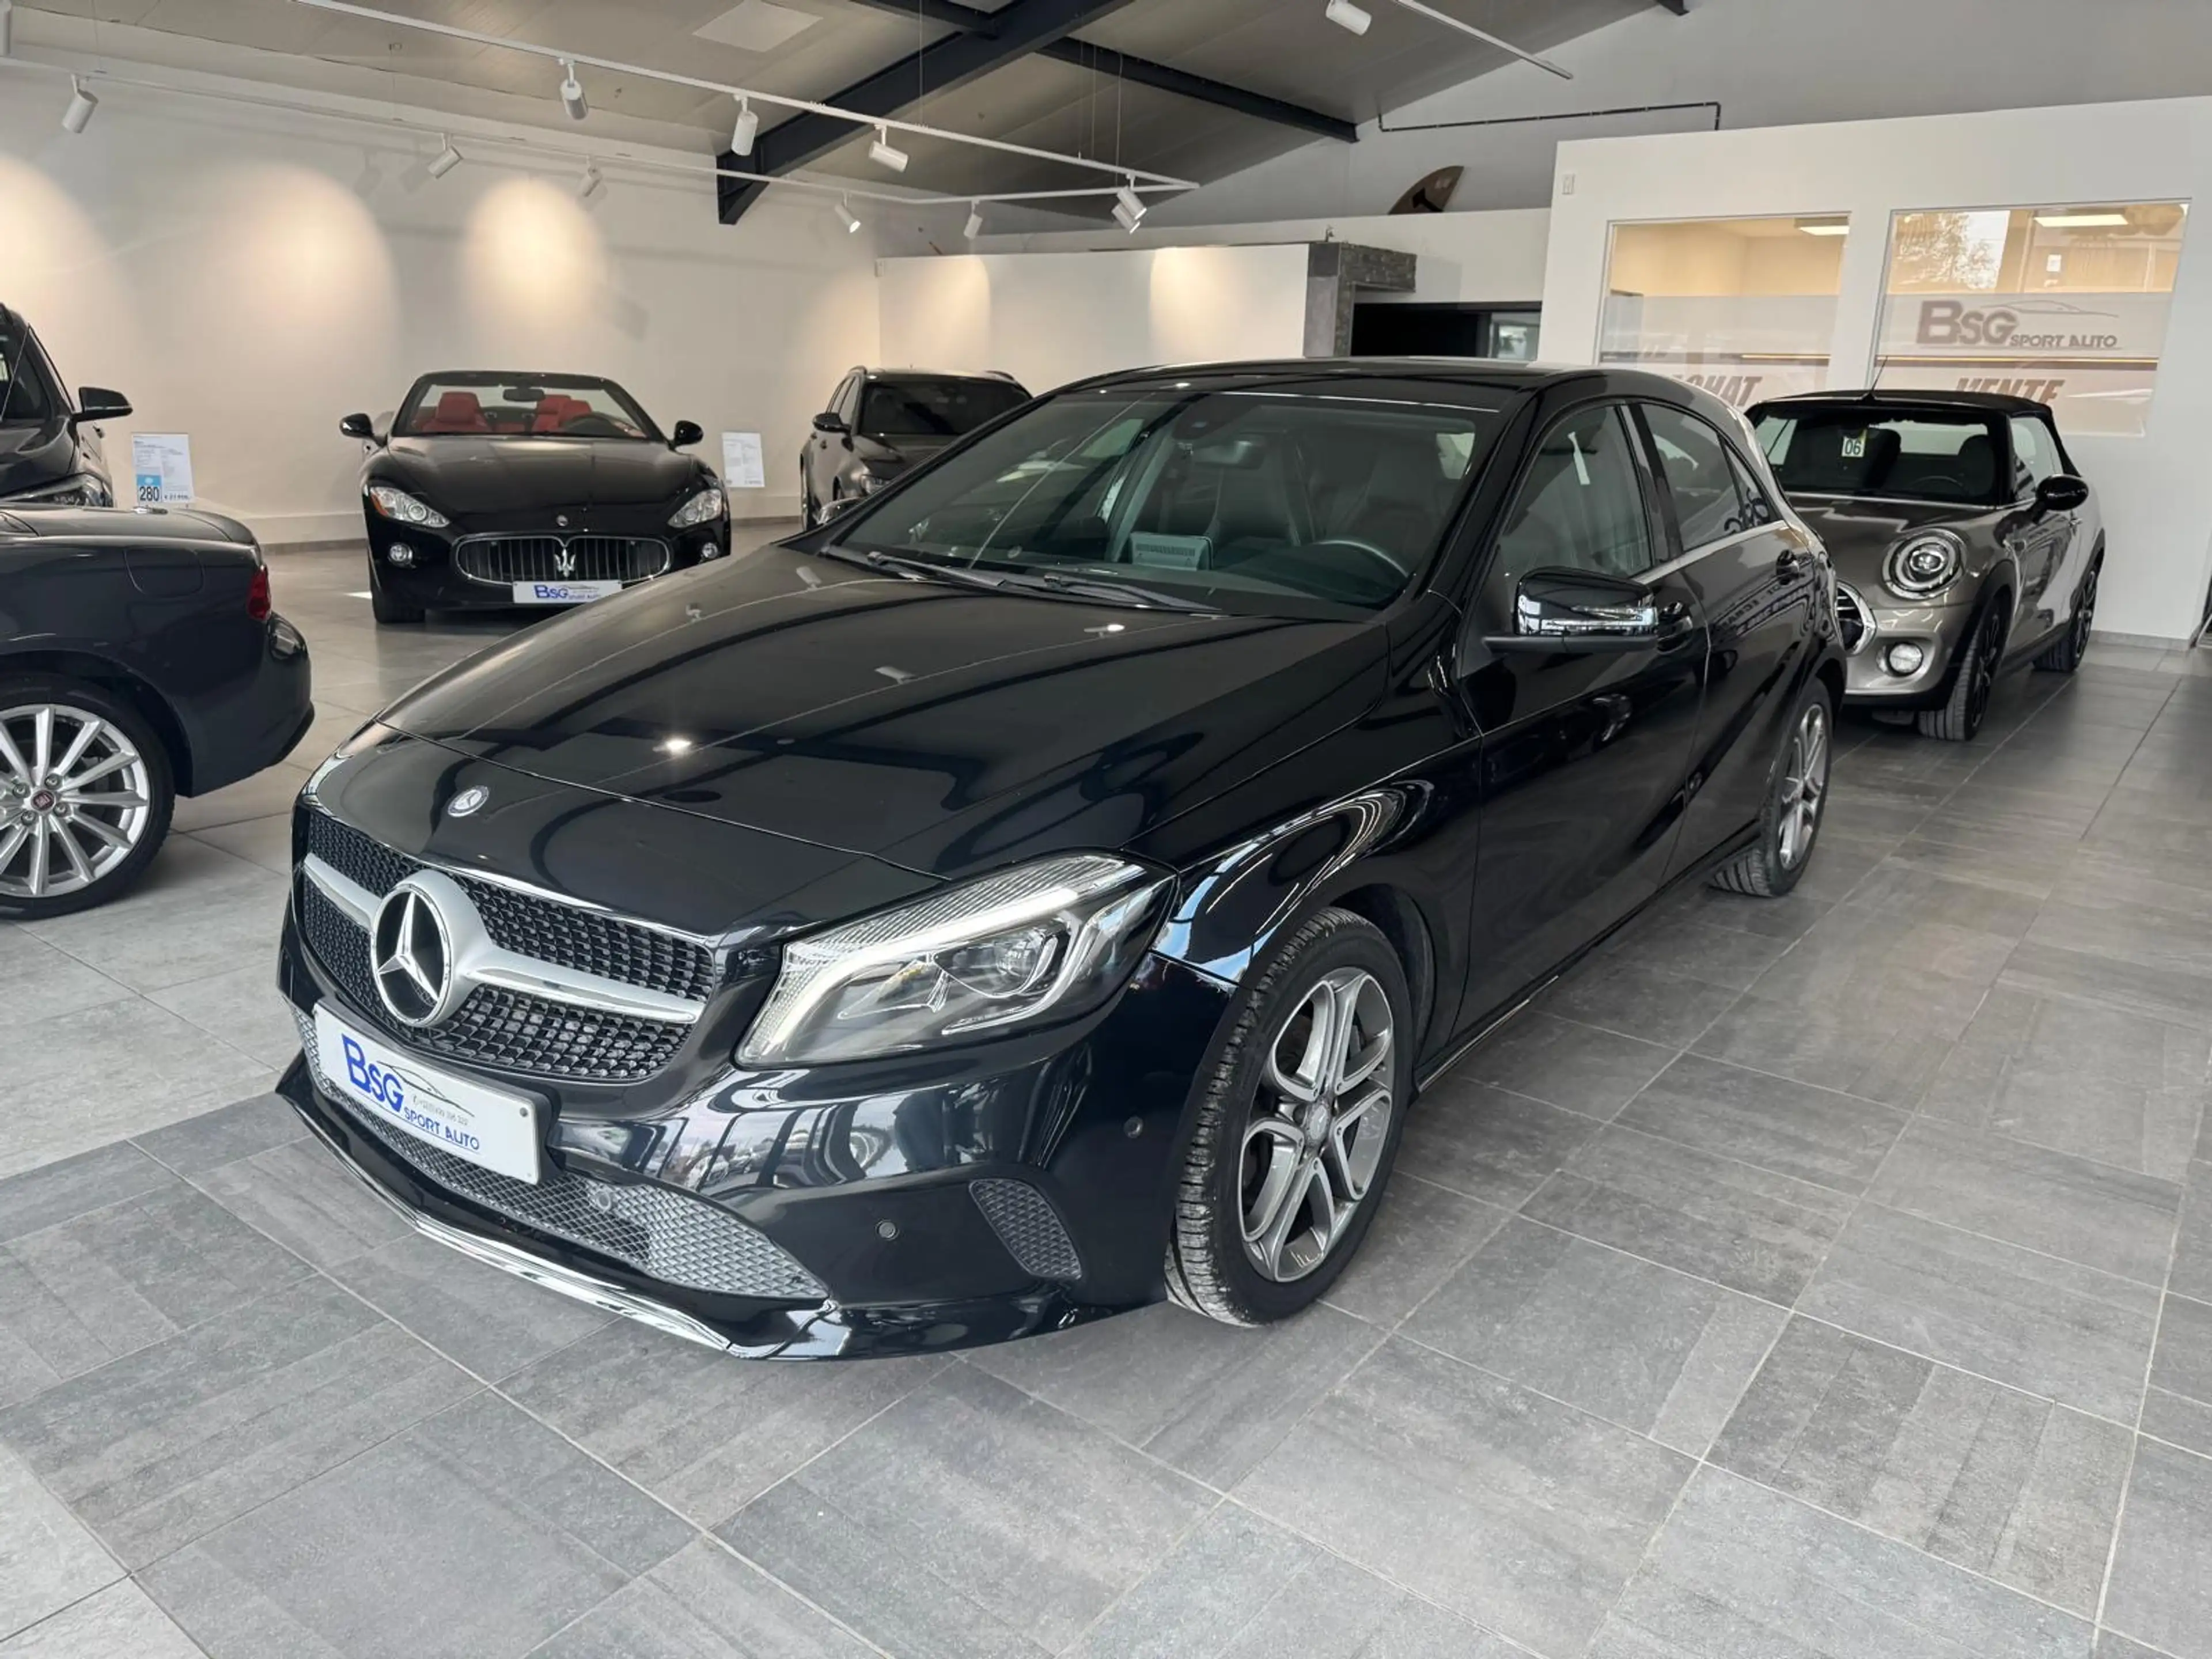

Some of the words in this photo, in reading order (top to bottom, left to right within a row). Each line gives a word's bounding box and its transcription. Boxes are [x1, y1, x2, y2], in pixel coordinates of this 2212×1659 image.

[1916, 300, 2018, 344] BSG
[2010, 334, 2065, 347] SPORT
[2069, 334, 2118, 347] AUTO
[1672, 374, 1763, 407] HAT
[1844, 440, 1861, 455] 06
[140, 487, 160, 502] 280
[341, 1032, 404, 1112] BSG
[404, 1107, 441, 1135] SPORT
[445, 1125, 480, 1151] AUTO
